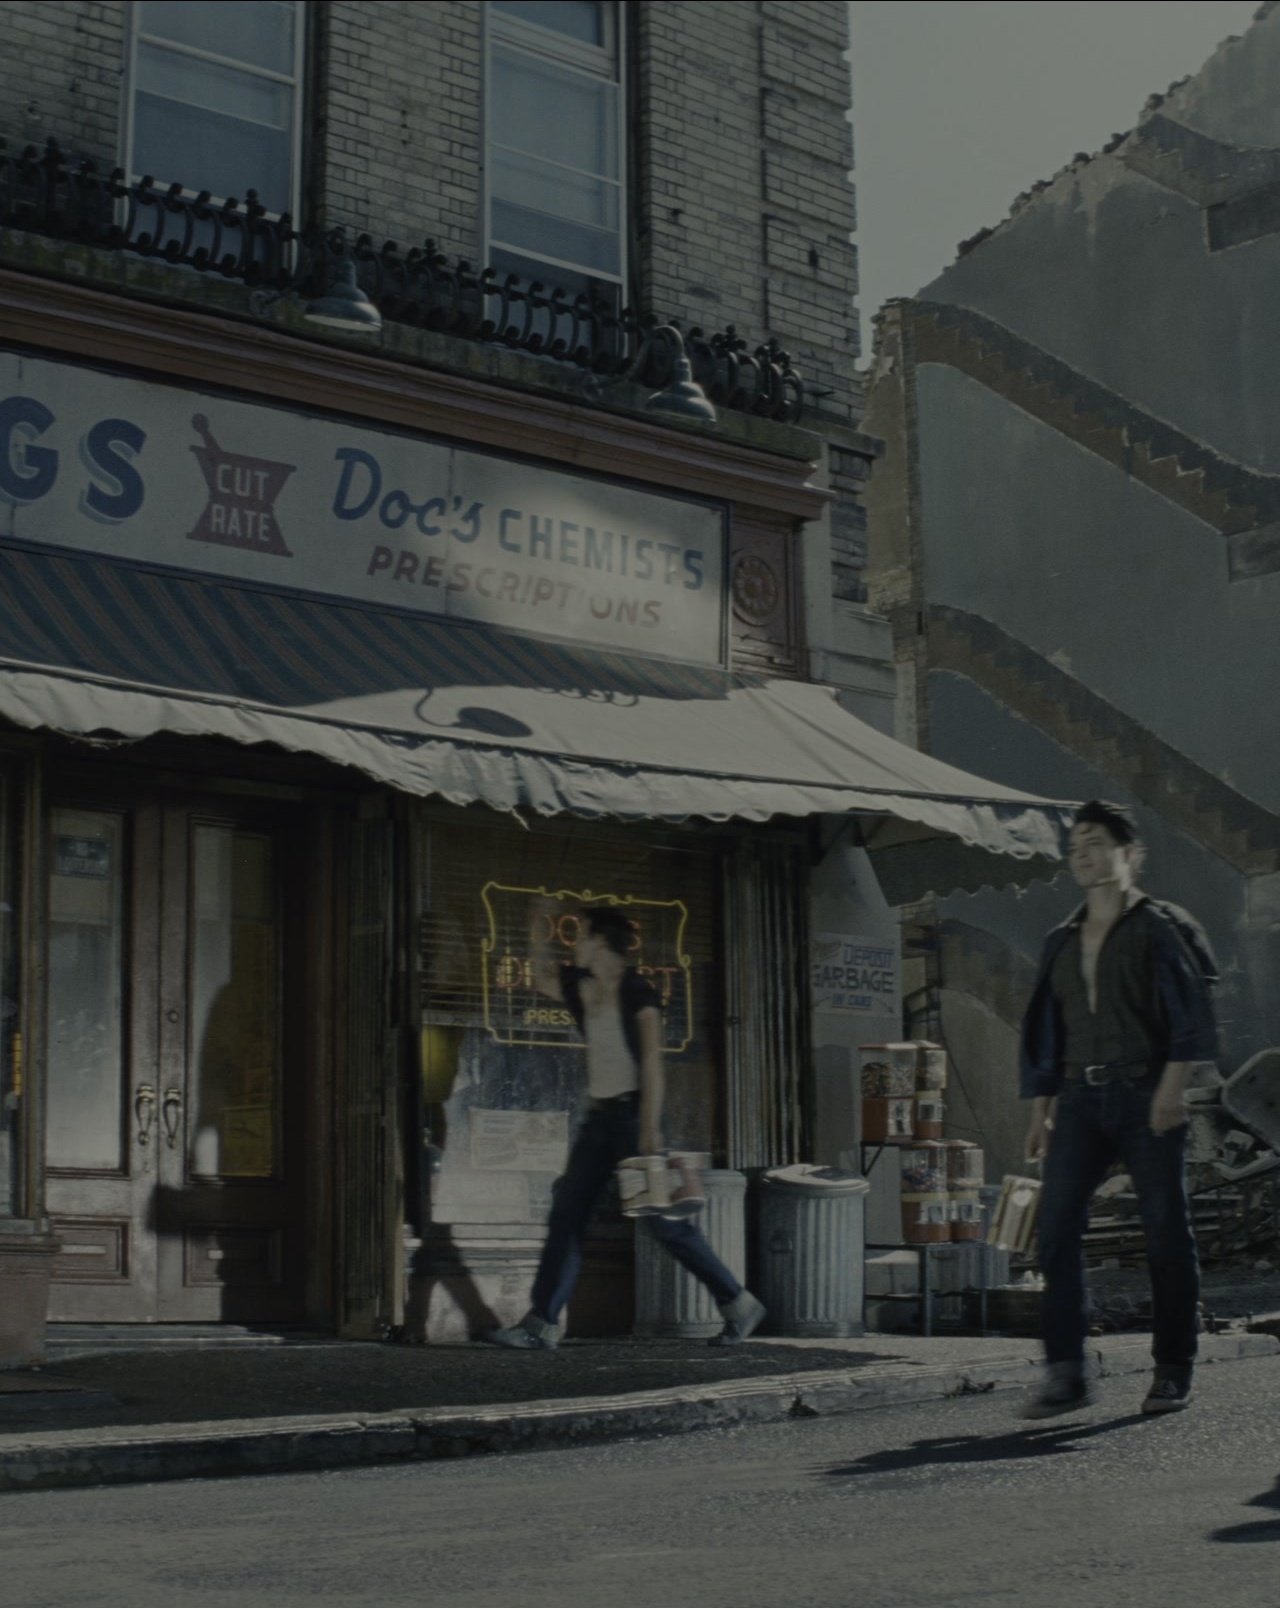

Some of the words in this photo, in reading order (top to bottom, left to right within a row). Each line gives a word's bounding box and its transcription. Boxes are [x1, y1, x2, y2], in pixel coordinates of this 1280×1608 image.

[216, 463, 270, 501] CUT
[211, 503, 272, 543] RATE
[333, 447, 483, 544] Doc's
[498, 507, 704, 591] CHEMISTS
[367, 545, 663, 629] PRESCRIPTONS
[813, 964, 895, 994] GARBAGE
